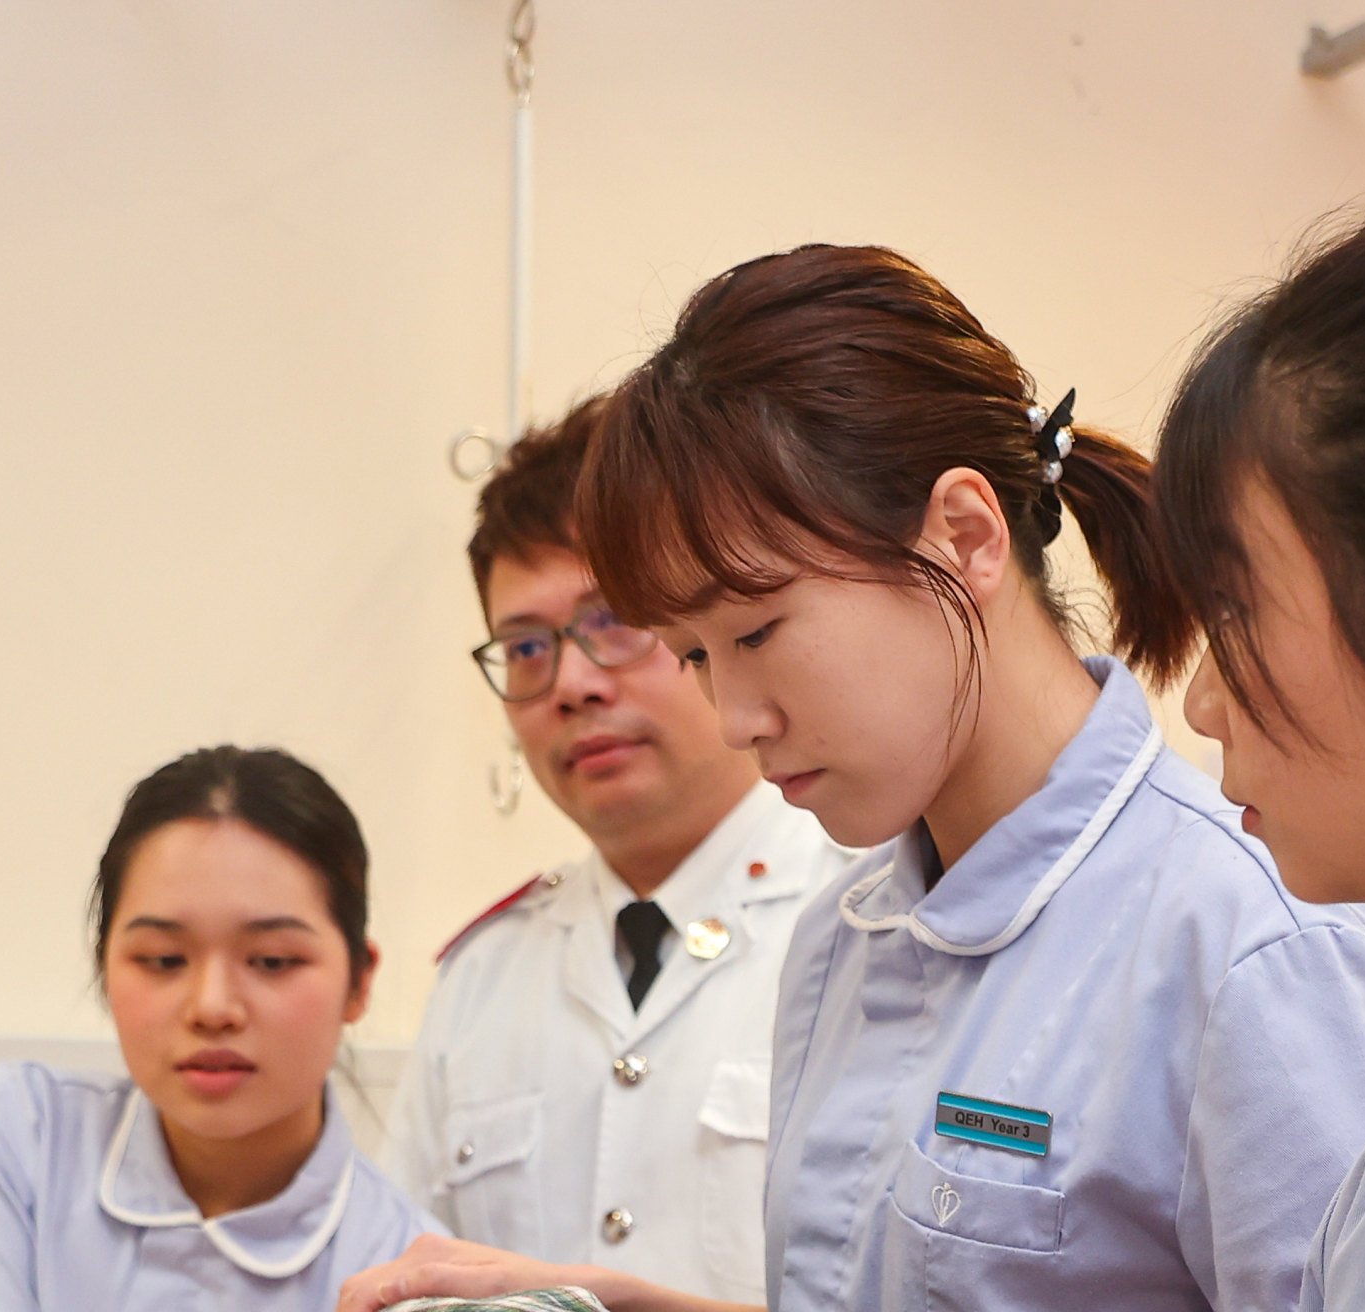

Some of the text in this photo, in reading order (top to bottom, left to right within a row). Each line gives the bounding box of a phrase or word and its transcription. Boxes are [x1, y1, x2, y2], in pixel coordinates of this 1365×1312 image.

[955, 1111, 1030, 1138] QEH Year 3
